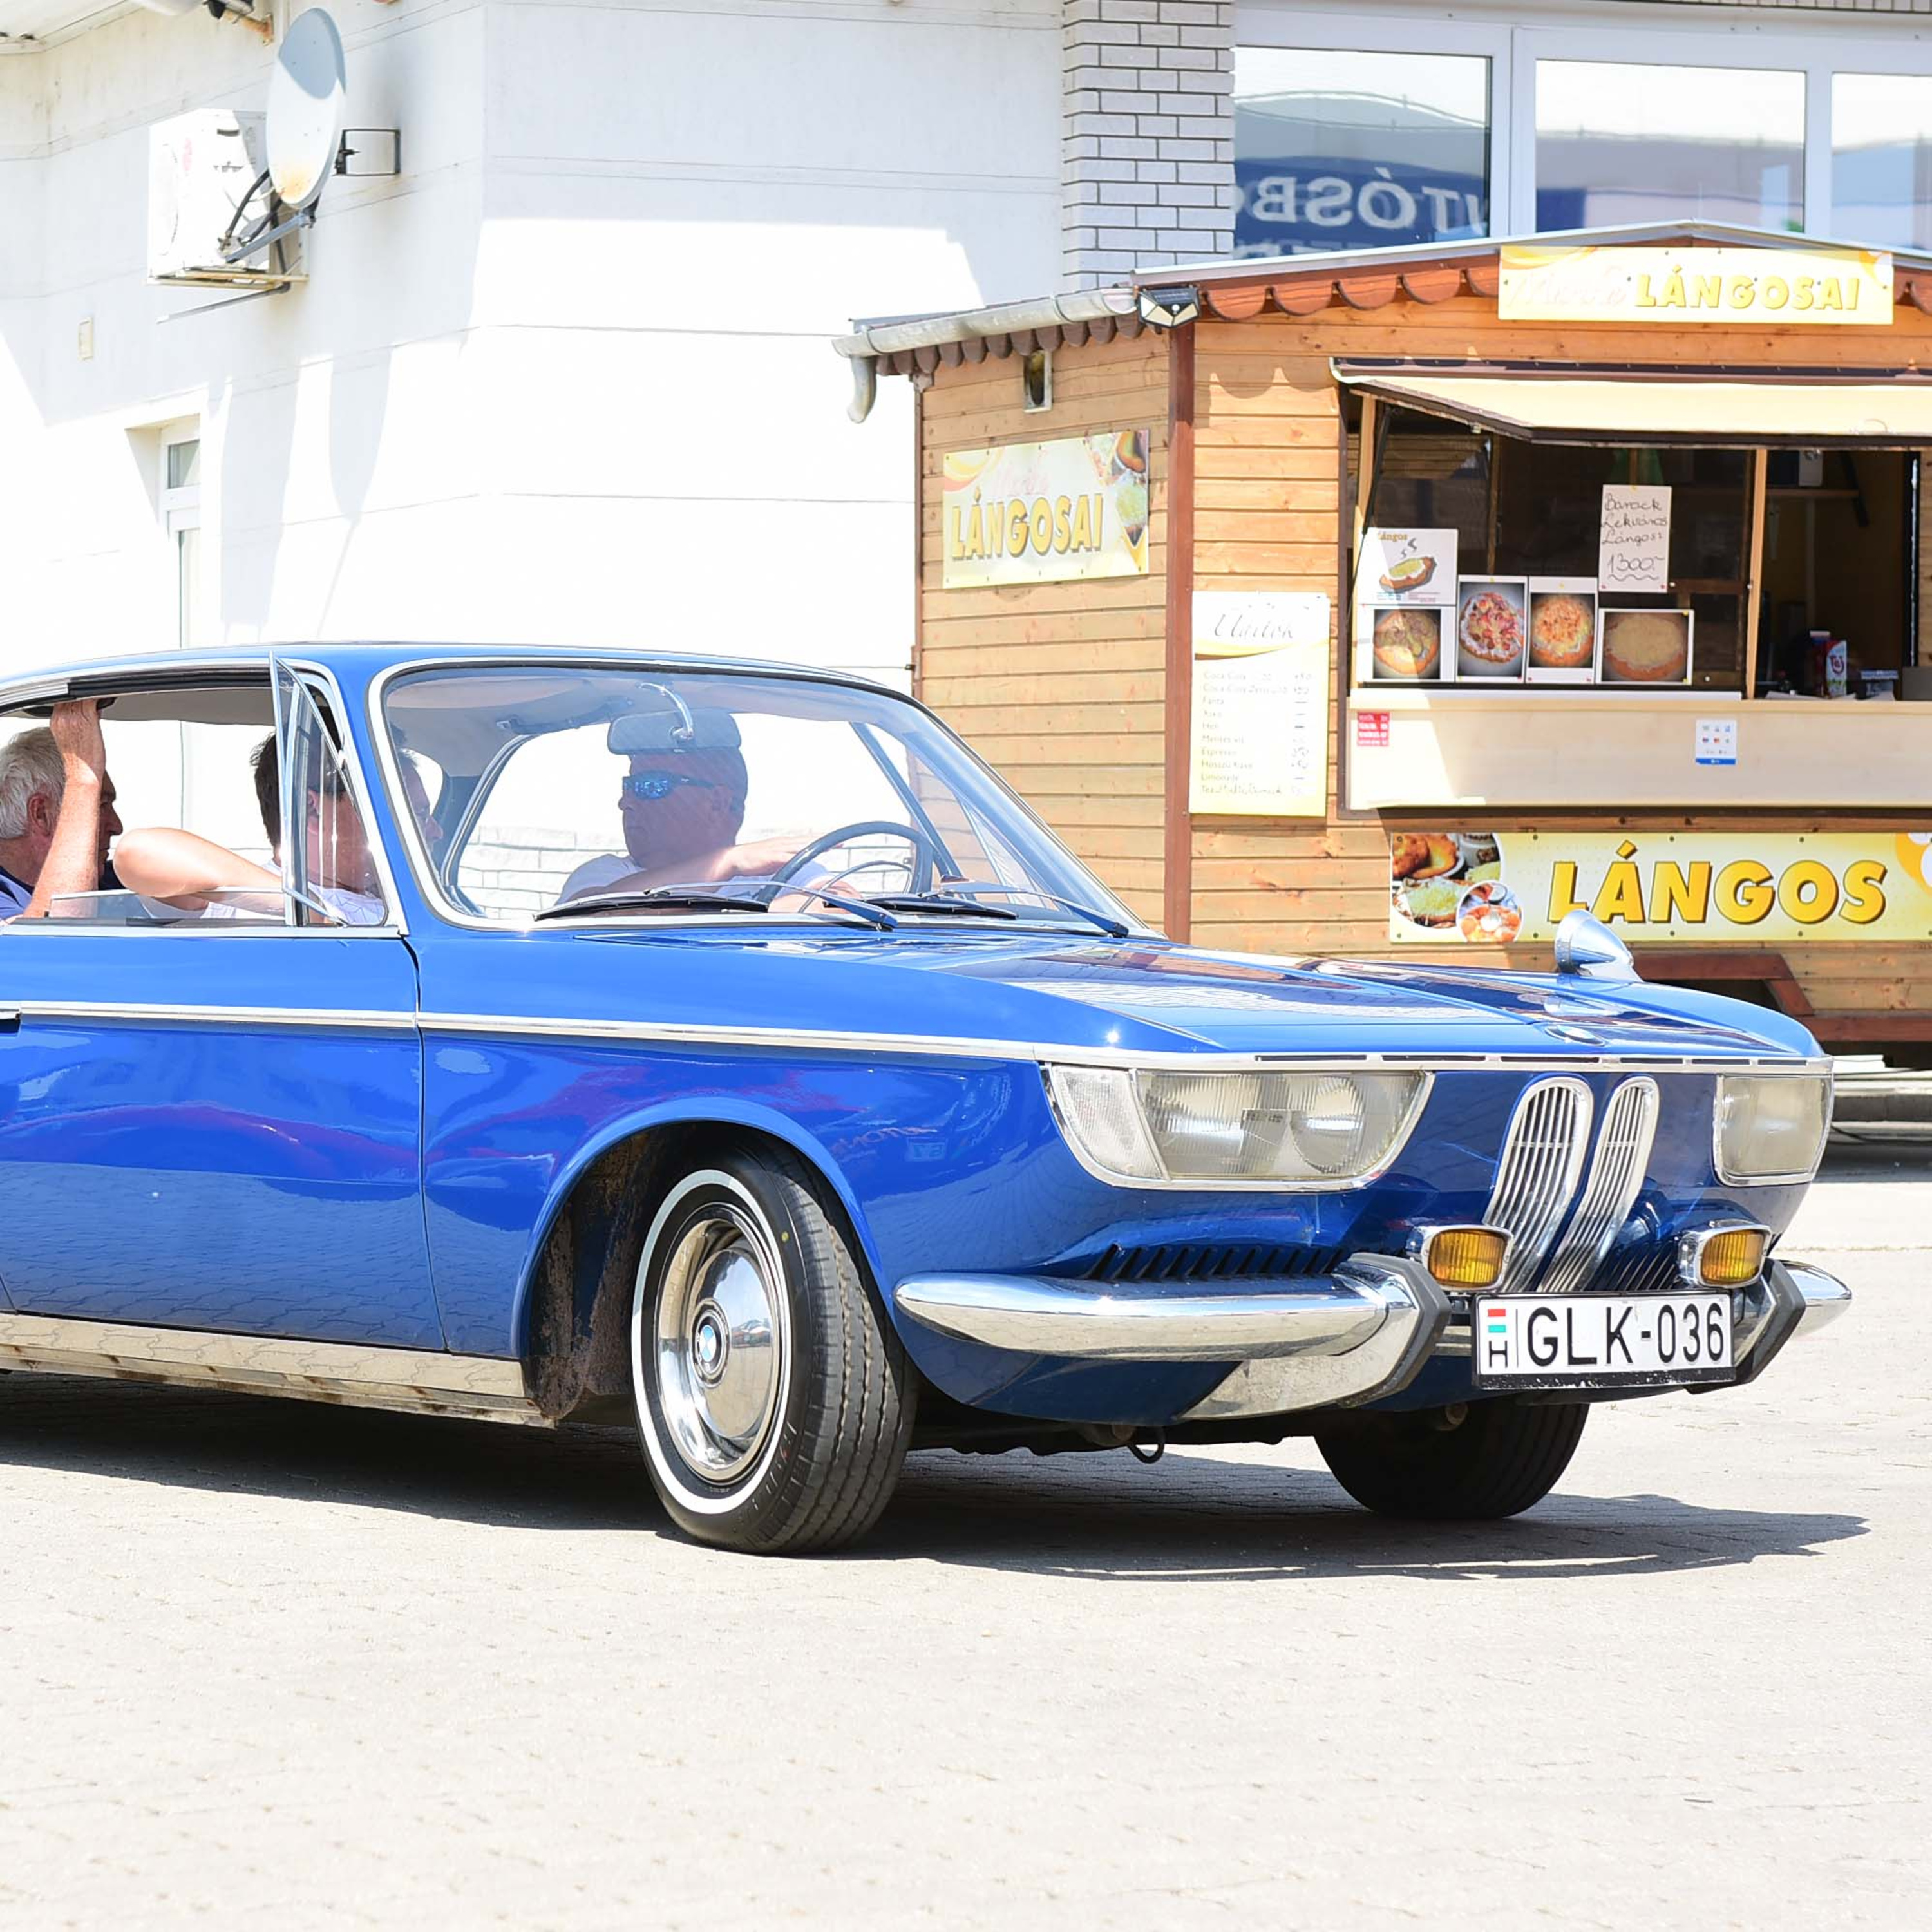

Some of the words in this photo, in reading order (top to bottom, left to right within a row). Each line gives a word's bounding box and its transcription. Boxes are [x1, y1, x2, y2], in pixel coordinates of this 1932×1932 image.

[1634, 265, 1861, 310] LÁNGOSAI
[952, 486, 1104, 561] LÁNGOSAI
[1605, 492, 1662, 511] Barack
[1378, 531, 1408, 542] ángos
[1547, 840, 1887, 925] LÁNGOS
[1489, 1340, 1508, 1368] H
[1527, 1303, 1724, 1367] GLK-036
